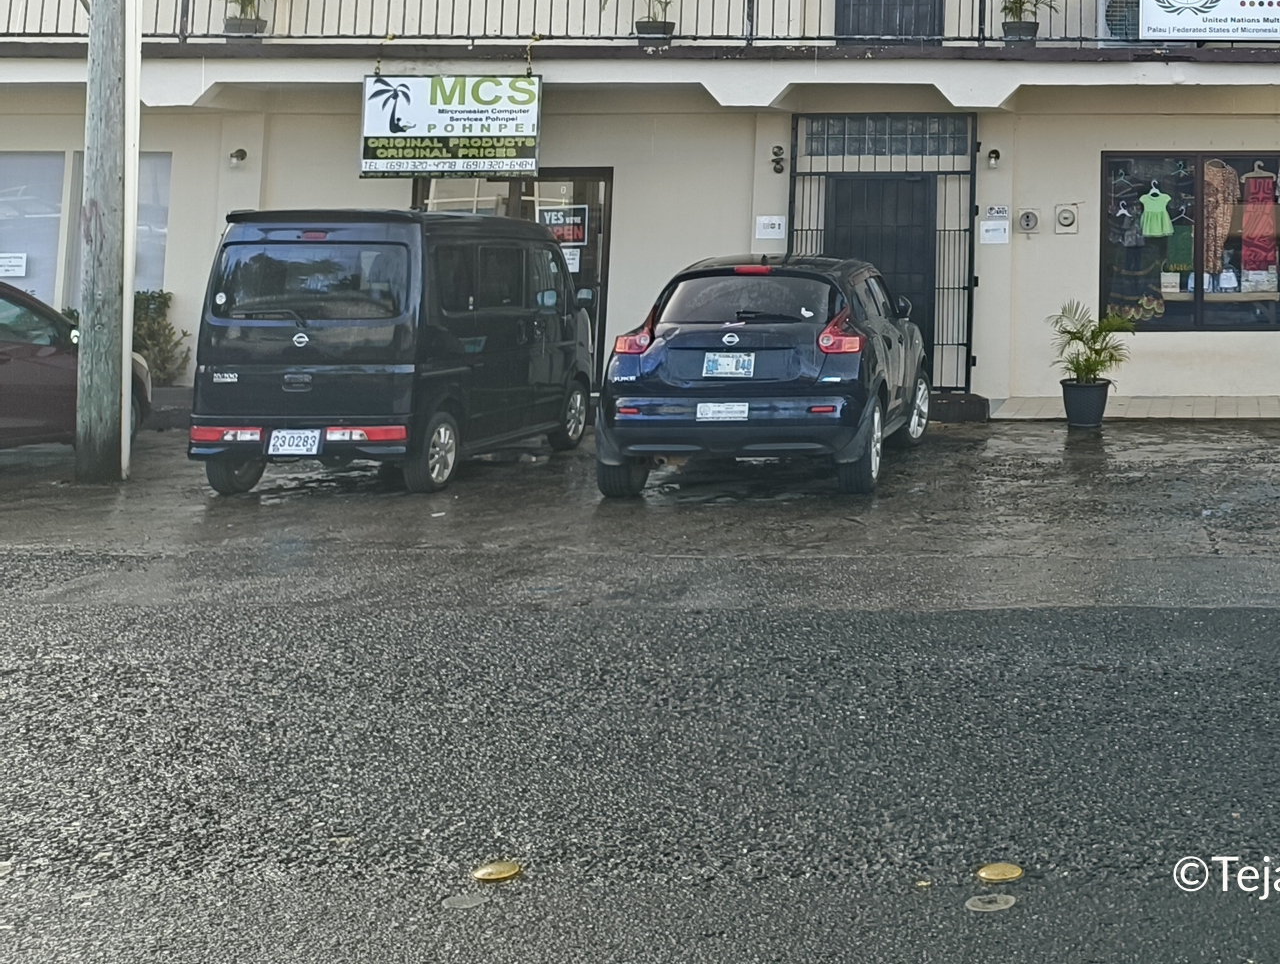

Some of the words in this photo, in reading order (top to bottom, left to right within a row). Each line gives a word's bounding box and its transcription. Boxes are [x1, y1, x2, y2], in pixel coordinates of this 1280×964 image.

[1202, 16, 1228, 24] United
[1230, 16, 1261, 24] Nations
[1147, 26, 1167, 34] Palau
[1172, 26, 1207, 34] Federated
[1208, 26, 1230, 34] States
[1231, 26, 1239, 34] of
[1240, 26, 1278, 34] Micronesia
[430, 77, 536, 106] MCS
[491, 108, 530, 117] Computer
[485, 115, 518, 124] Pohnpei
[427, 123, 536, 133] POHNPEI
[367, 137, 443, 148] ORIGINAL
[449, 137, 536, 148] PRODUCTS
[376, 148, 452, 158] ORIGINAL
[458, 147, 517, 158] PRICES
[544, 211, 564, 224] YES
